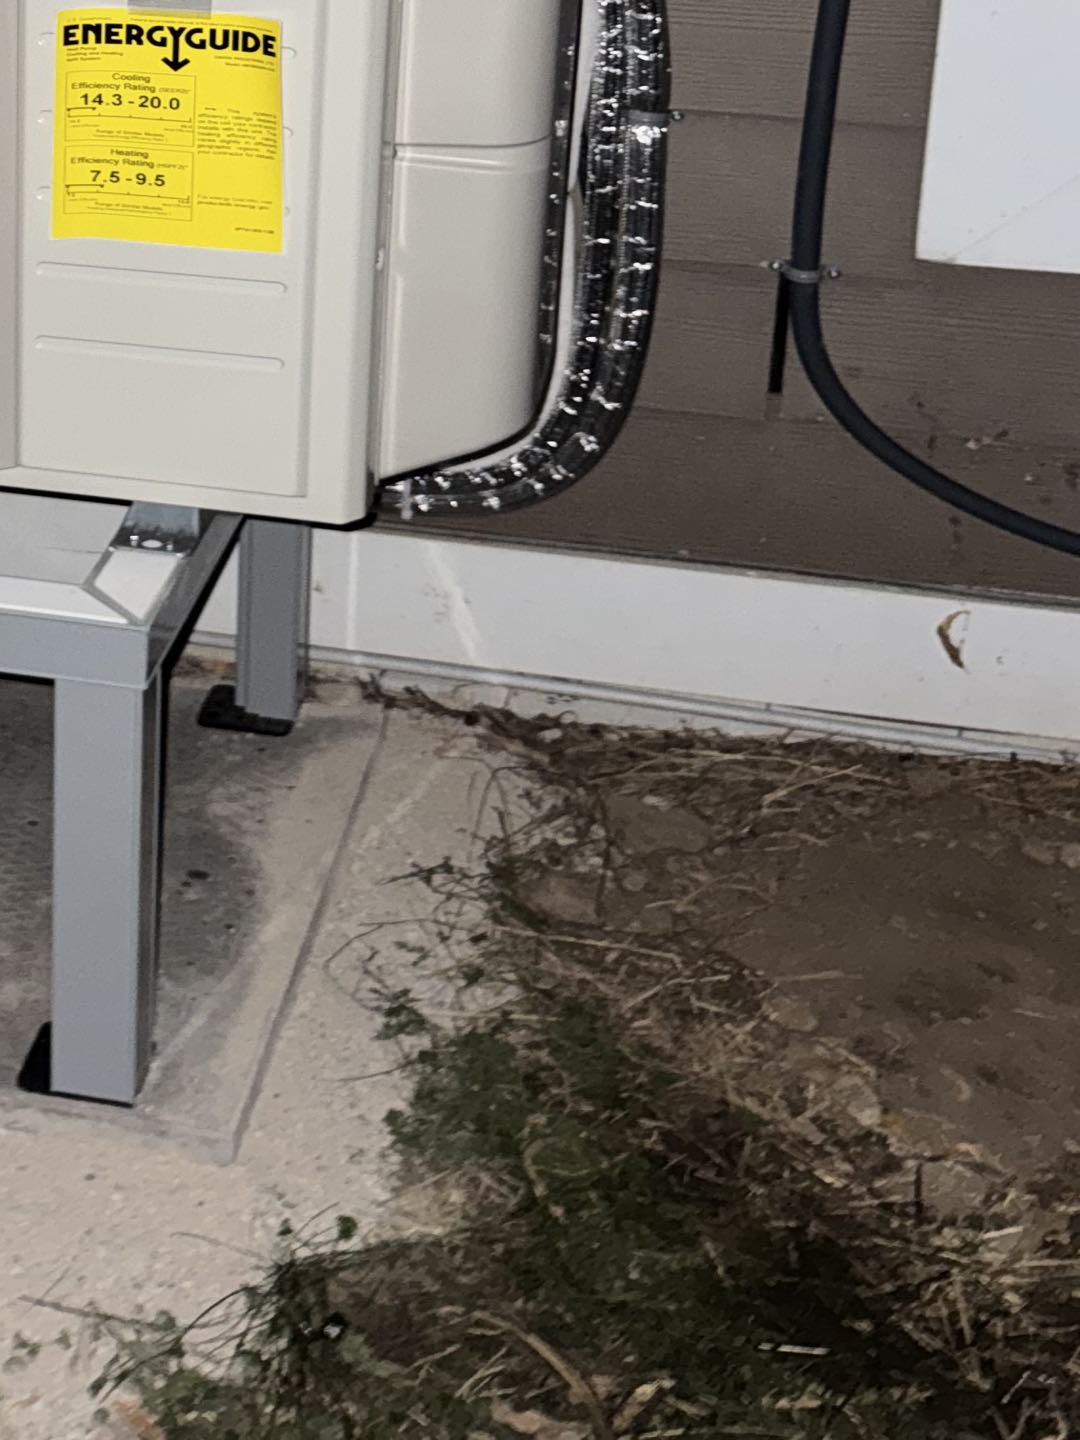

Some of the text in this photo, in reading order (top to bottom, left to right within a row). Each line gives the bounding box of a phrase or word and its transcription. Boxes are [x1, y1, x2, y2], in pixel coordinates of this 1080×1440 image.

[63, 23, 277, 59] ENERGYGUIDE
[112, 72, 151, 83] Cooling
[71, 82, 121, 91] Efficiency
[123, 82, 156, 93] Rating
[110, 148, 149, 159] Heating
[70, 157, 120, 166] Efficiency
[122, 158, 155, 169] Rating
